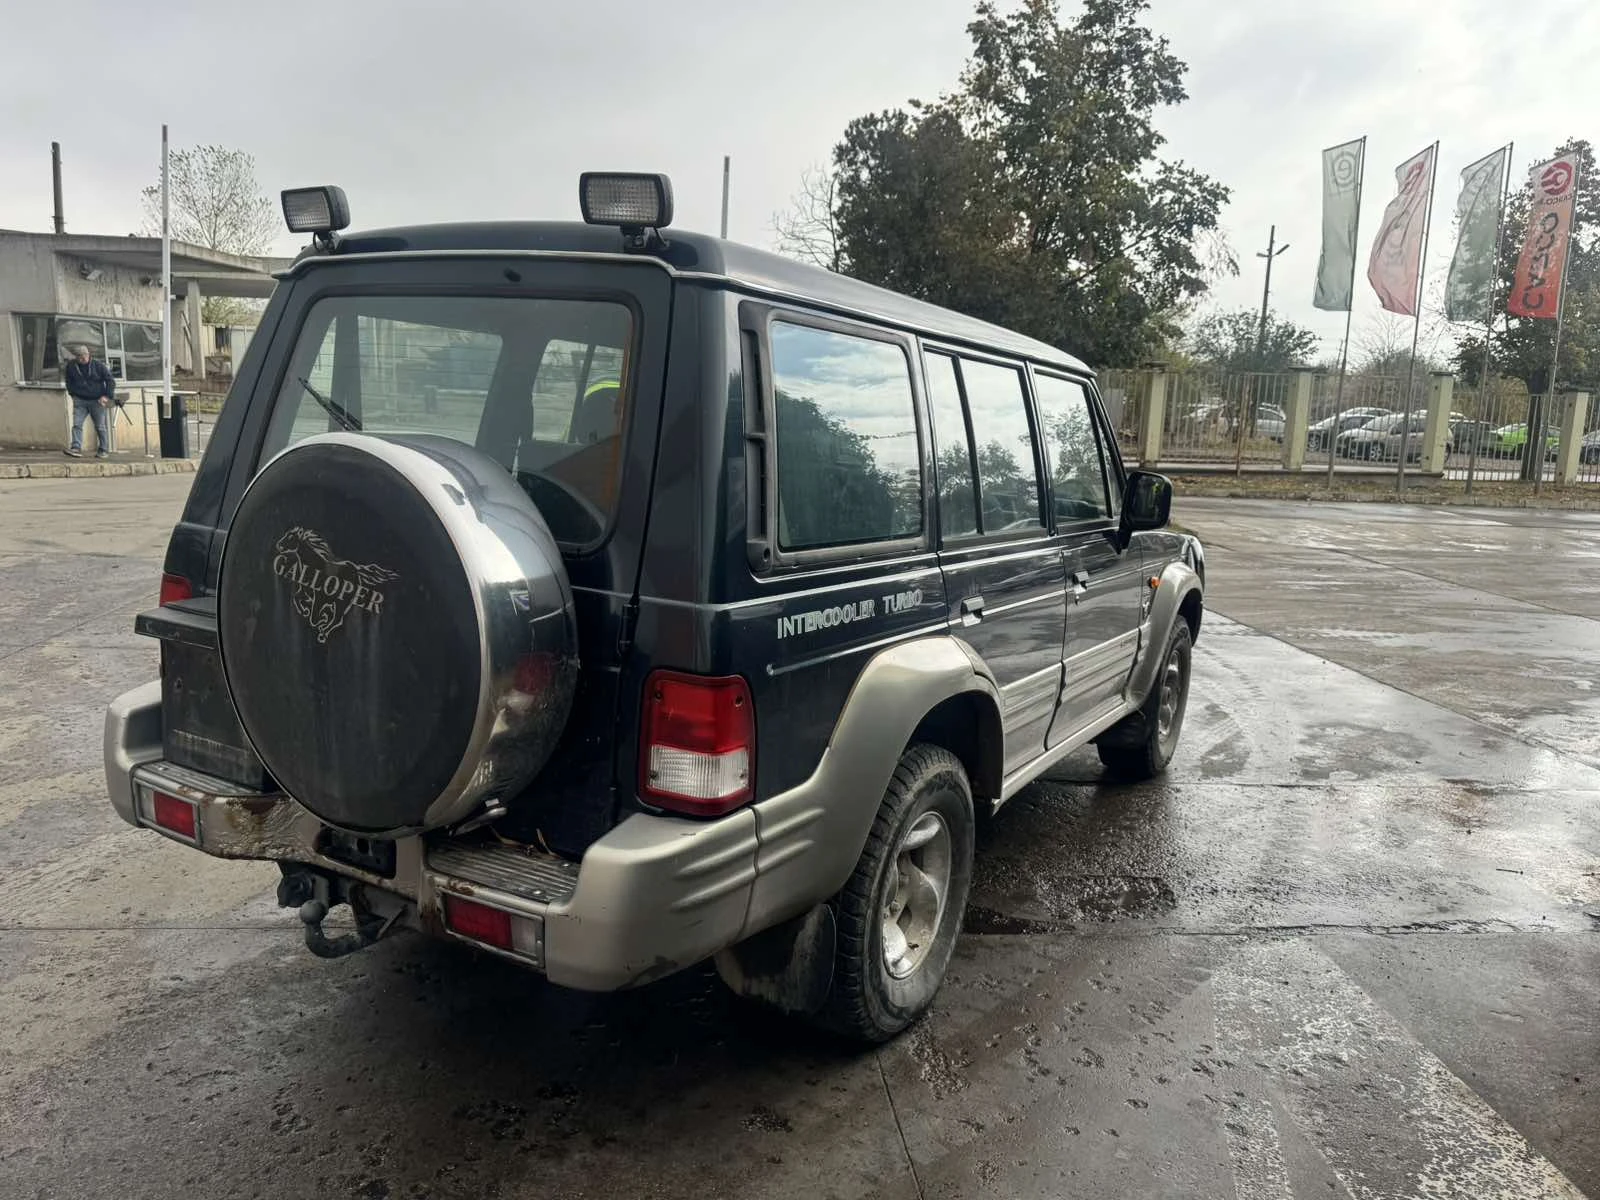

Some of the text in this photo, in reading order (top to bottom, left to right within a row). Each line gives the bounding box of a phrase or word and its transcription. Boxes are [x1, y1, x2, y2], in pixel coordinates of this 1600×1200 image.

[273, 554, 385, 615] GALLOPER
[777, 588, 924, 639] INTERCOOLER TURBO
